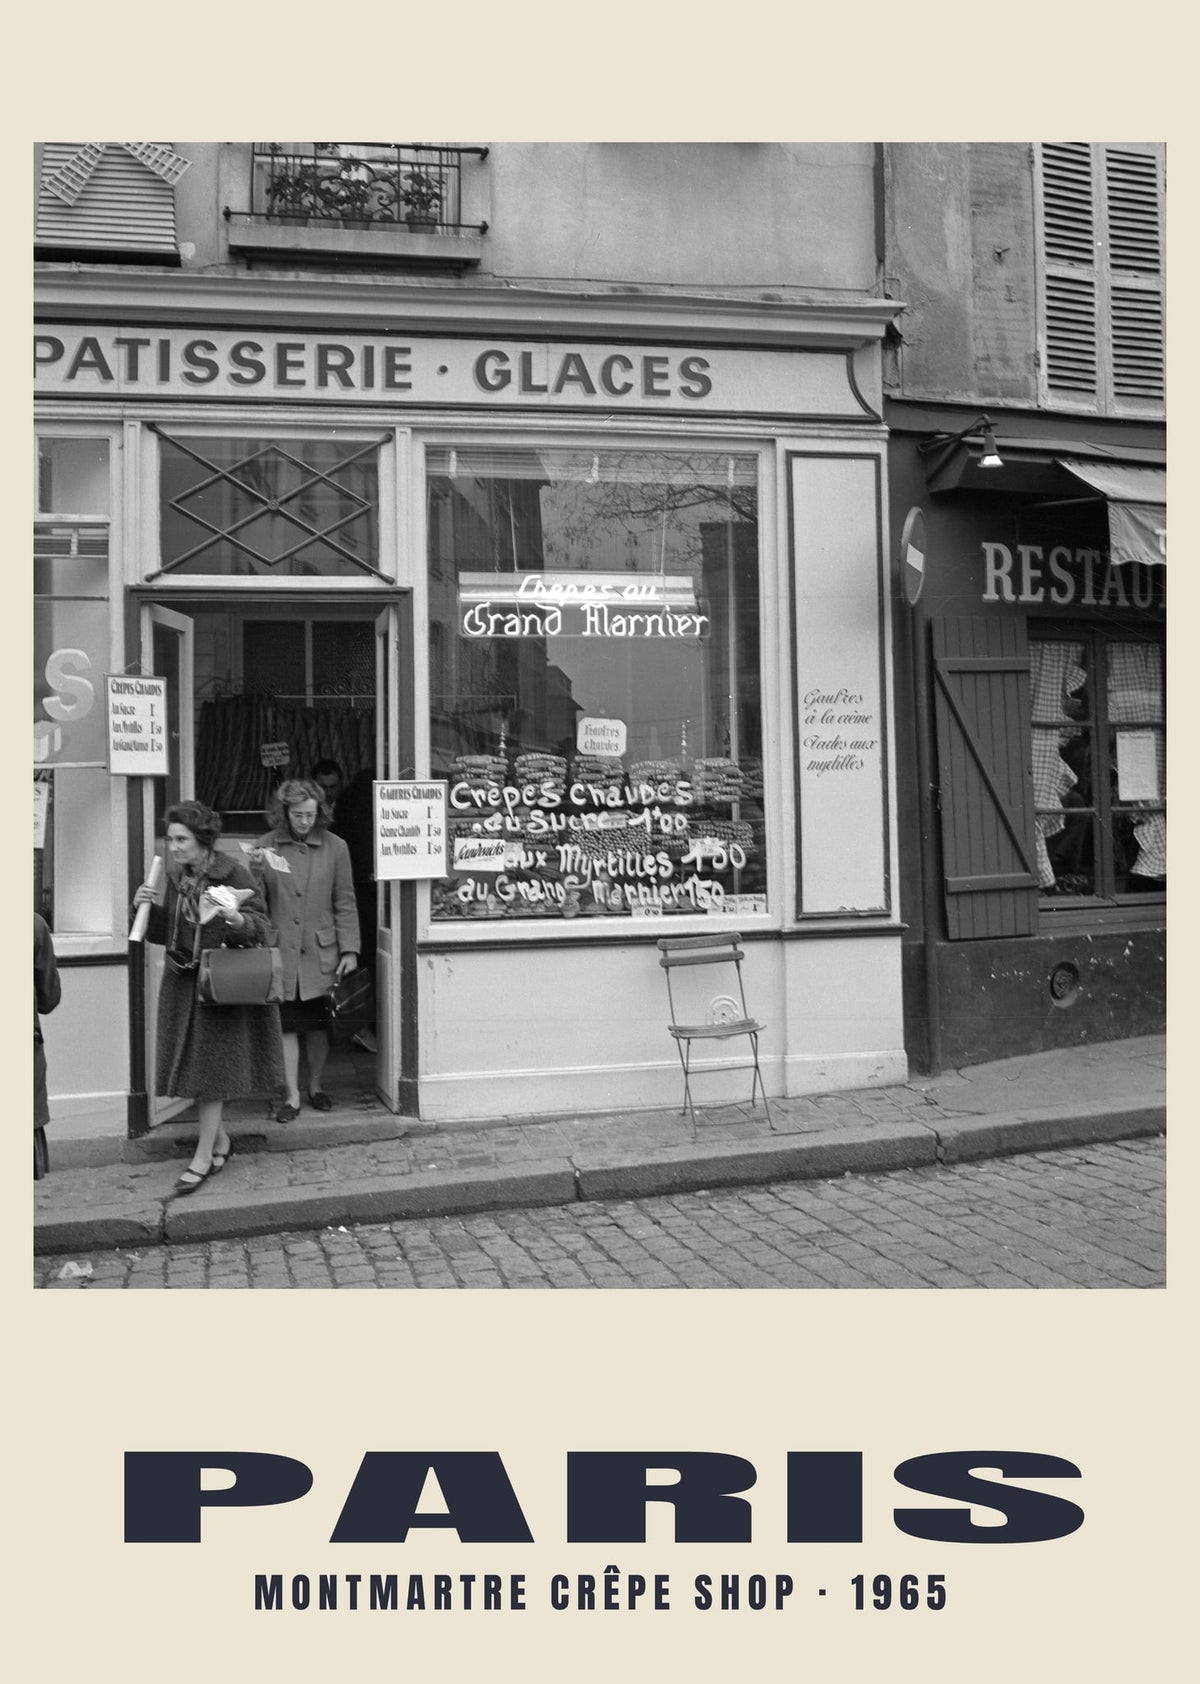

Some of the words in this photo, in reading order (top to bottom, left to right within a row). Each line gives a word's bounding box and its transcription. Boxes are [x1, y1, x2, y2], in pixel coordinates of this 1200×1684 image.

[33, 335, 412, 390] PATISSERIE
[474, 348, 713, 399] GLACES
[981, 541, 1166, 608] RESTAU
[463, 601, 562, 636] Grand
[581, 602, 709, 637] Marnier
[821, 708, 834, 724] la
[457, 878, 488, 902] au
